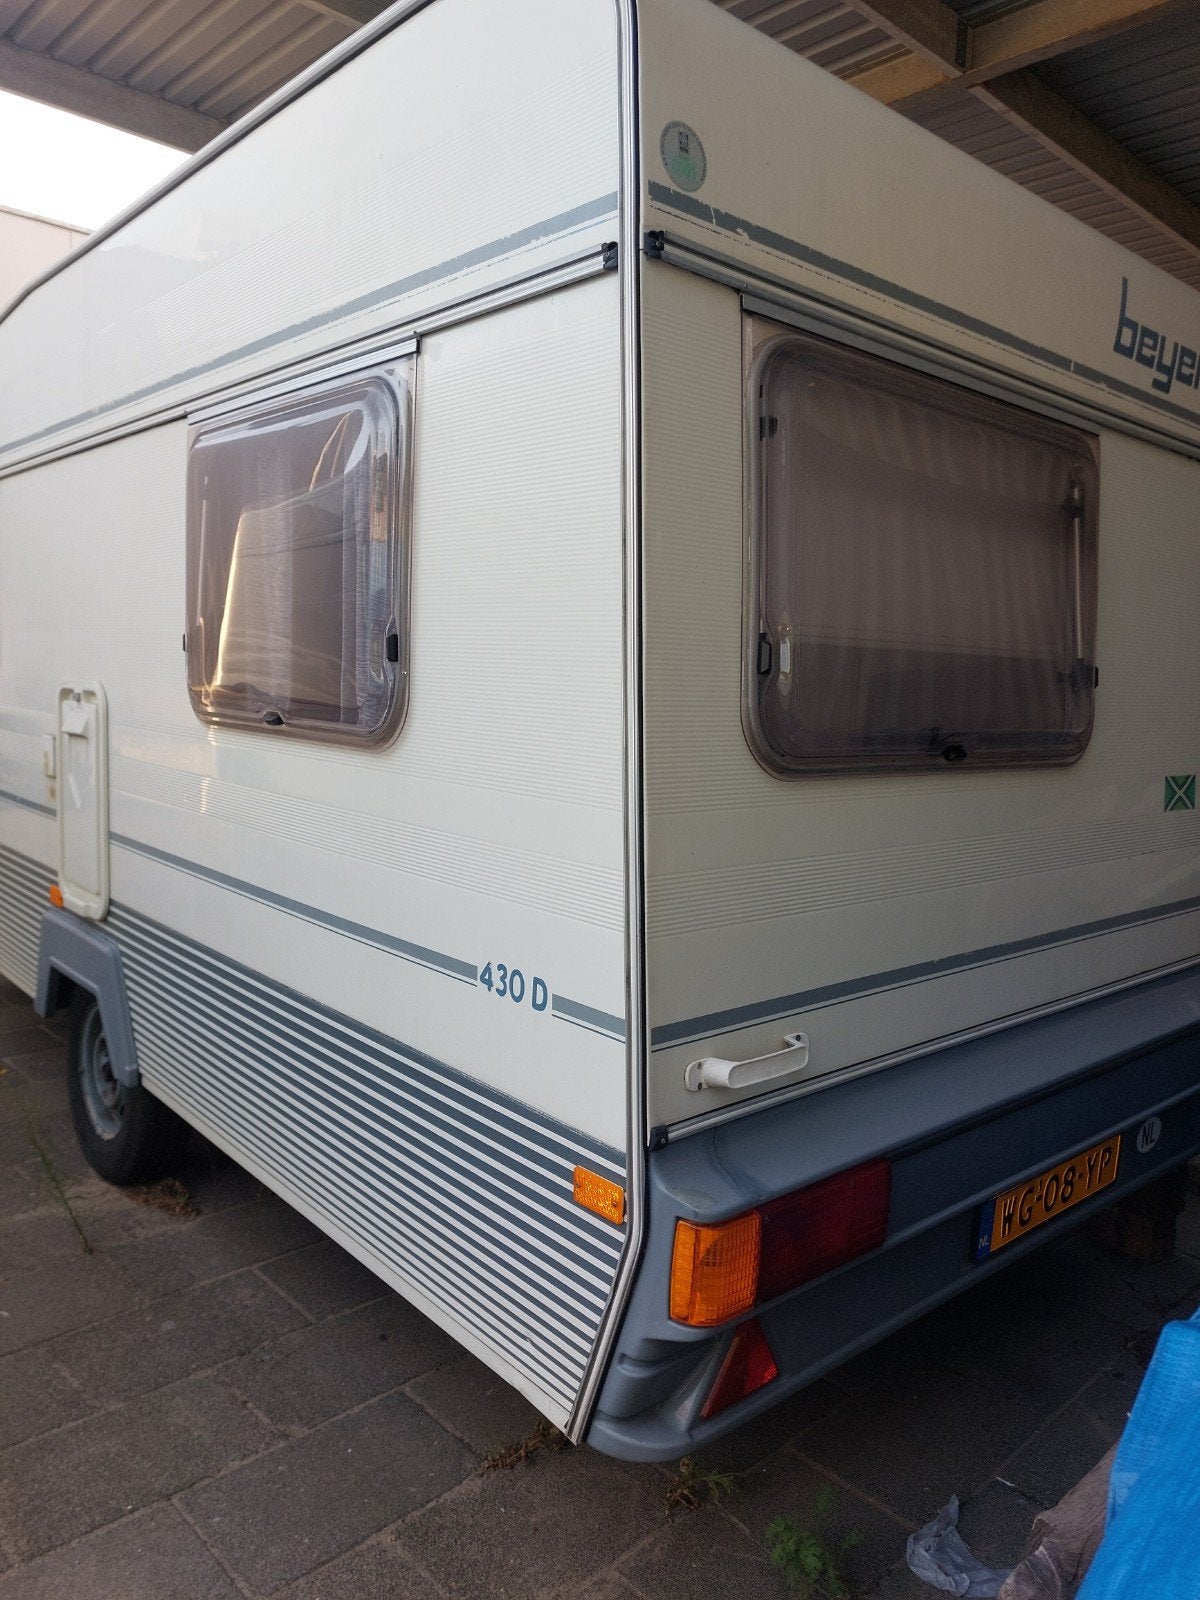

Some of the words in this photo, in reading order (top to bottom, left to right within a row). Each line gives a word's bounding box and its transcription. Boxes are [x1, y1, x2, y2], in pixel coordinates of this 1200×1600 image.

[480, 961, 525, 1003] 430
[531, 976, 548, 1012] D
[1140, 1121, 1156, 1149] NL
[1001, 1146, 1112, 1238] WG-08-YP
[978, 1234, 990, 1249] NL
